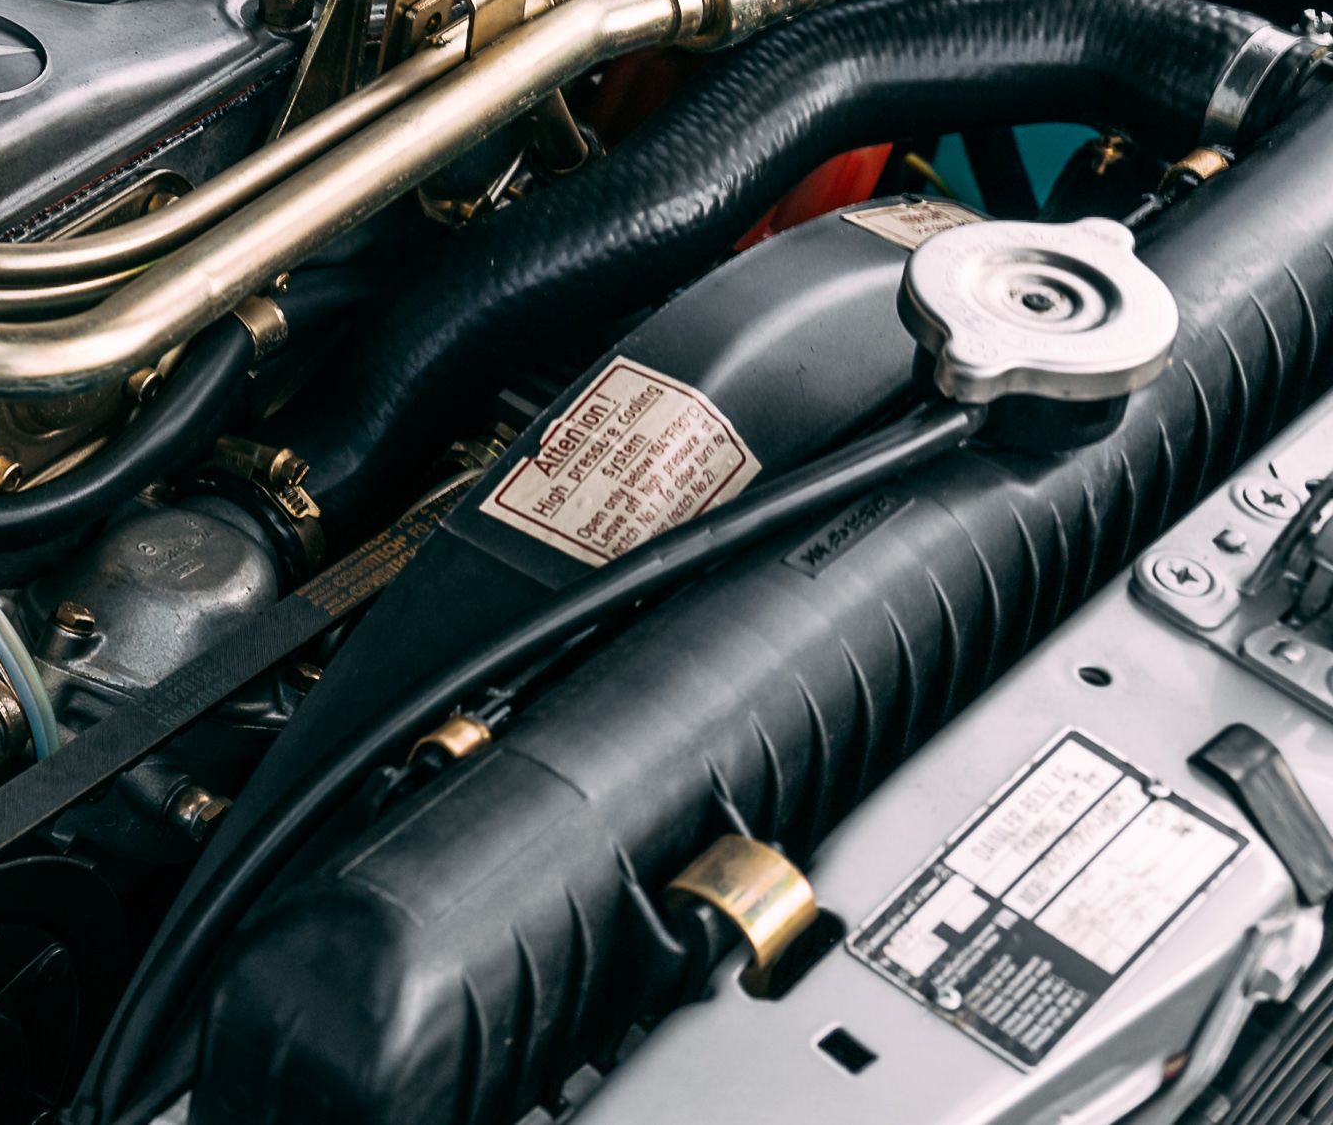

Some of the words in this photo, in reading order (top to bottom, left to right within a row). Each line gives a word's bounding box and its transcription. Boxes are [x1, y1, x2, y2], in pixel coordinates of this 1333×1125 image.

[532, 485, 568, 519] High
[618, 384, 665, 426] cooling
[533, 404, 608, 476] Attenion
[602, 434, 646, 478] system
[658, 488, 675, 503] To
[674, 465, 696, 490] close
[694, 445, 715, 467] turn
[576, 511, 608, 539] Open
[604, 488, 632, 510] only
[622, 457, 653, 488] below
[592, 515, 627, 548] Leave
[624, 496, 641, 513] off
[638, 474, 662, 496] high
[663, 436, 700, 476] pressure
